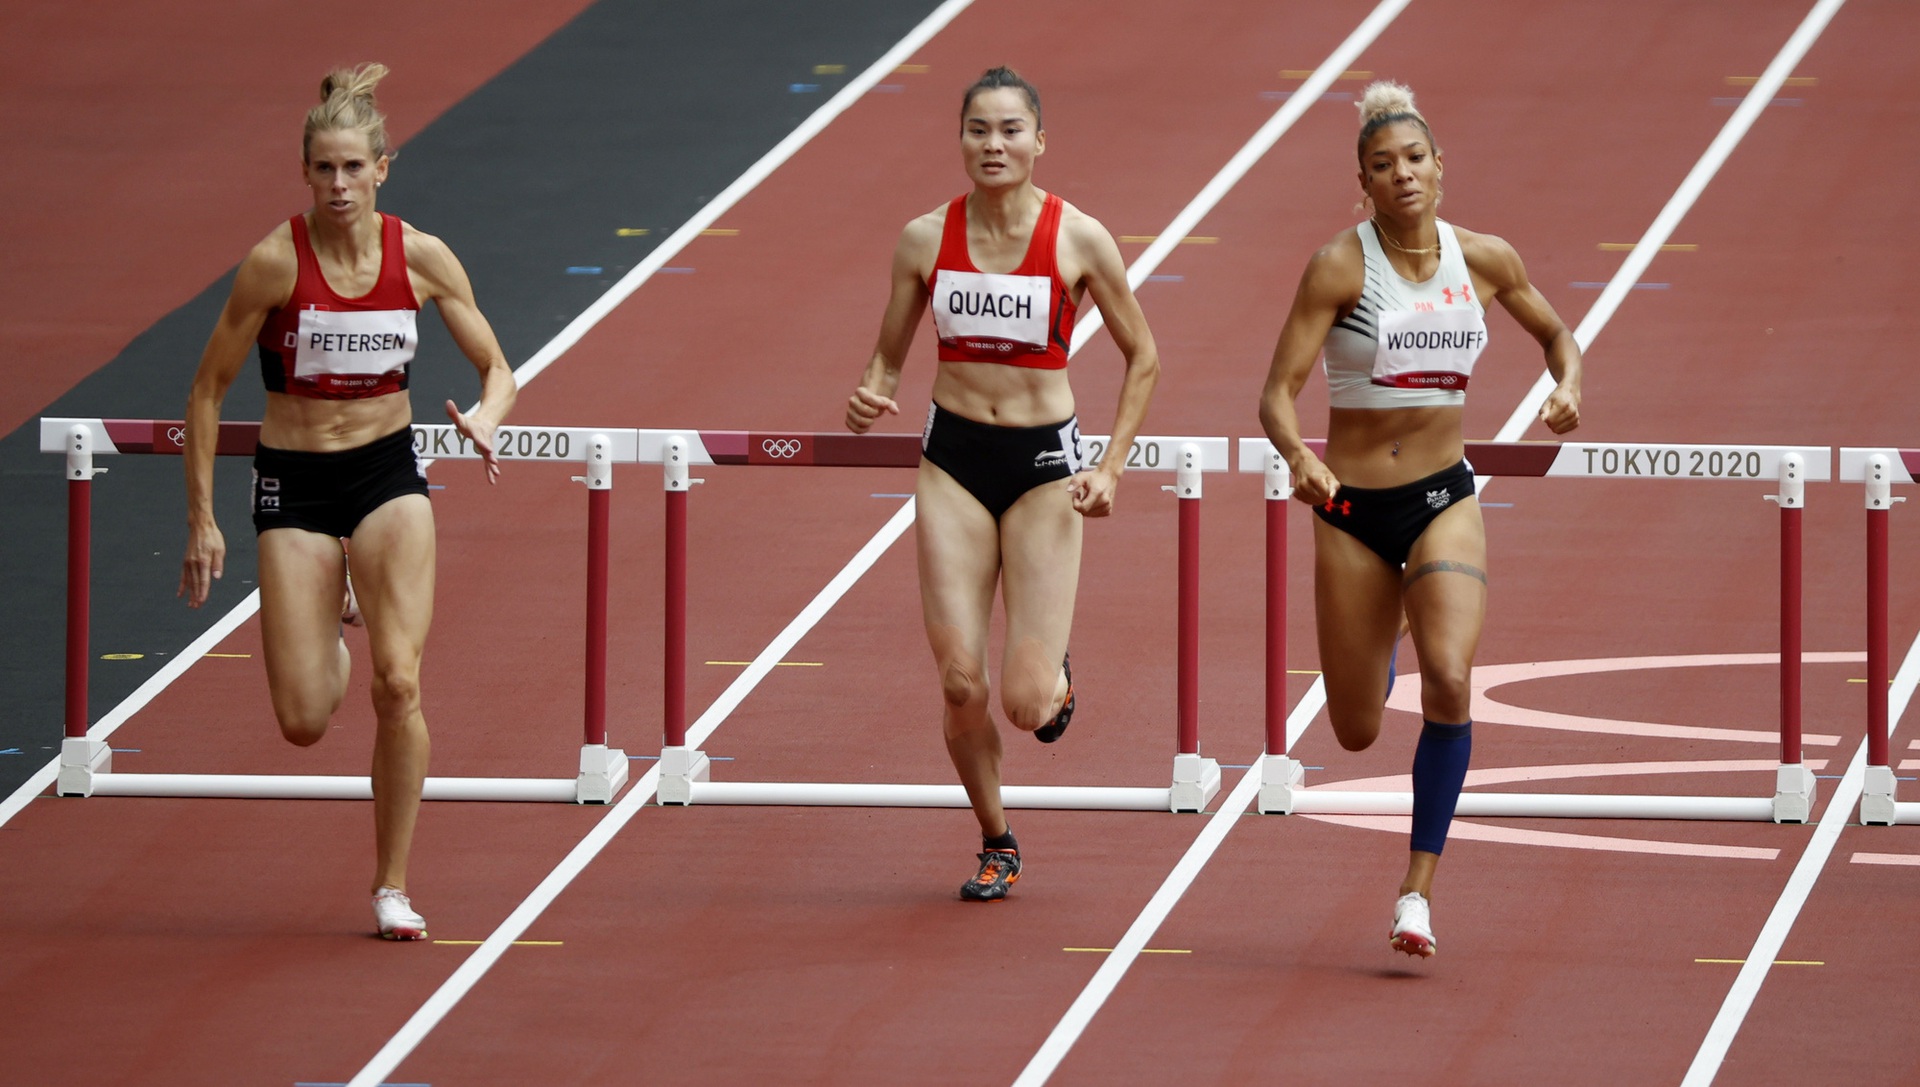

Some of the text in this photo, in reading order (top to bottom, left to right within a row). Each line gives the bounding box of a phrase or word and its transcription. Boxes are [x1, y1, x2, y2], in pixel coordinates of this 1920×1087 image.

[949, 290, 1031, 319] QUACH
[1414, 301, 1435, 313] PAN
[310, 332, 406, 352] PETERSEN
[966, 341, 982, 349] TOKYO
[1387, 330, 1484, 350] WOODRUFF
[411, 428, 570, 458] OKY 2020
[1089, 441, 1160, 468] 220
[1582, 448, 1761, 477] TOKYO 2020
[261, 477, 280, 512] DE
